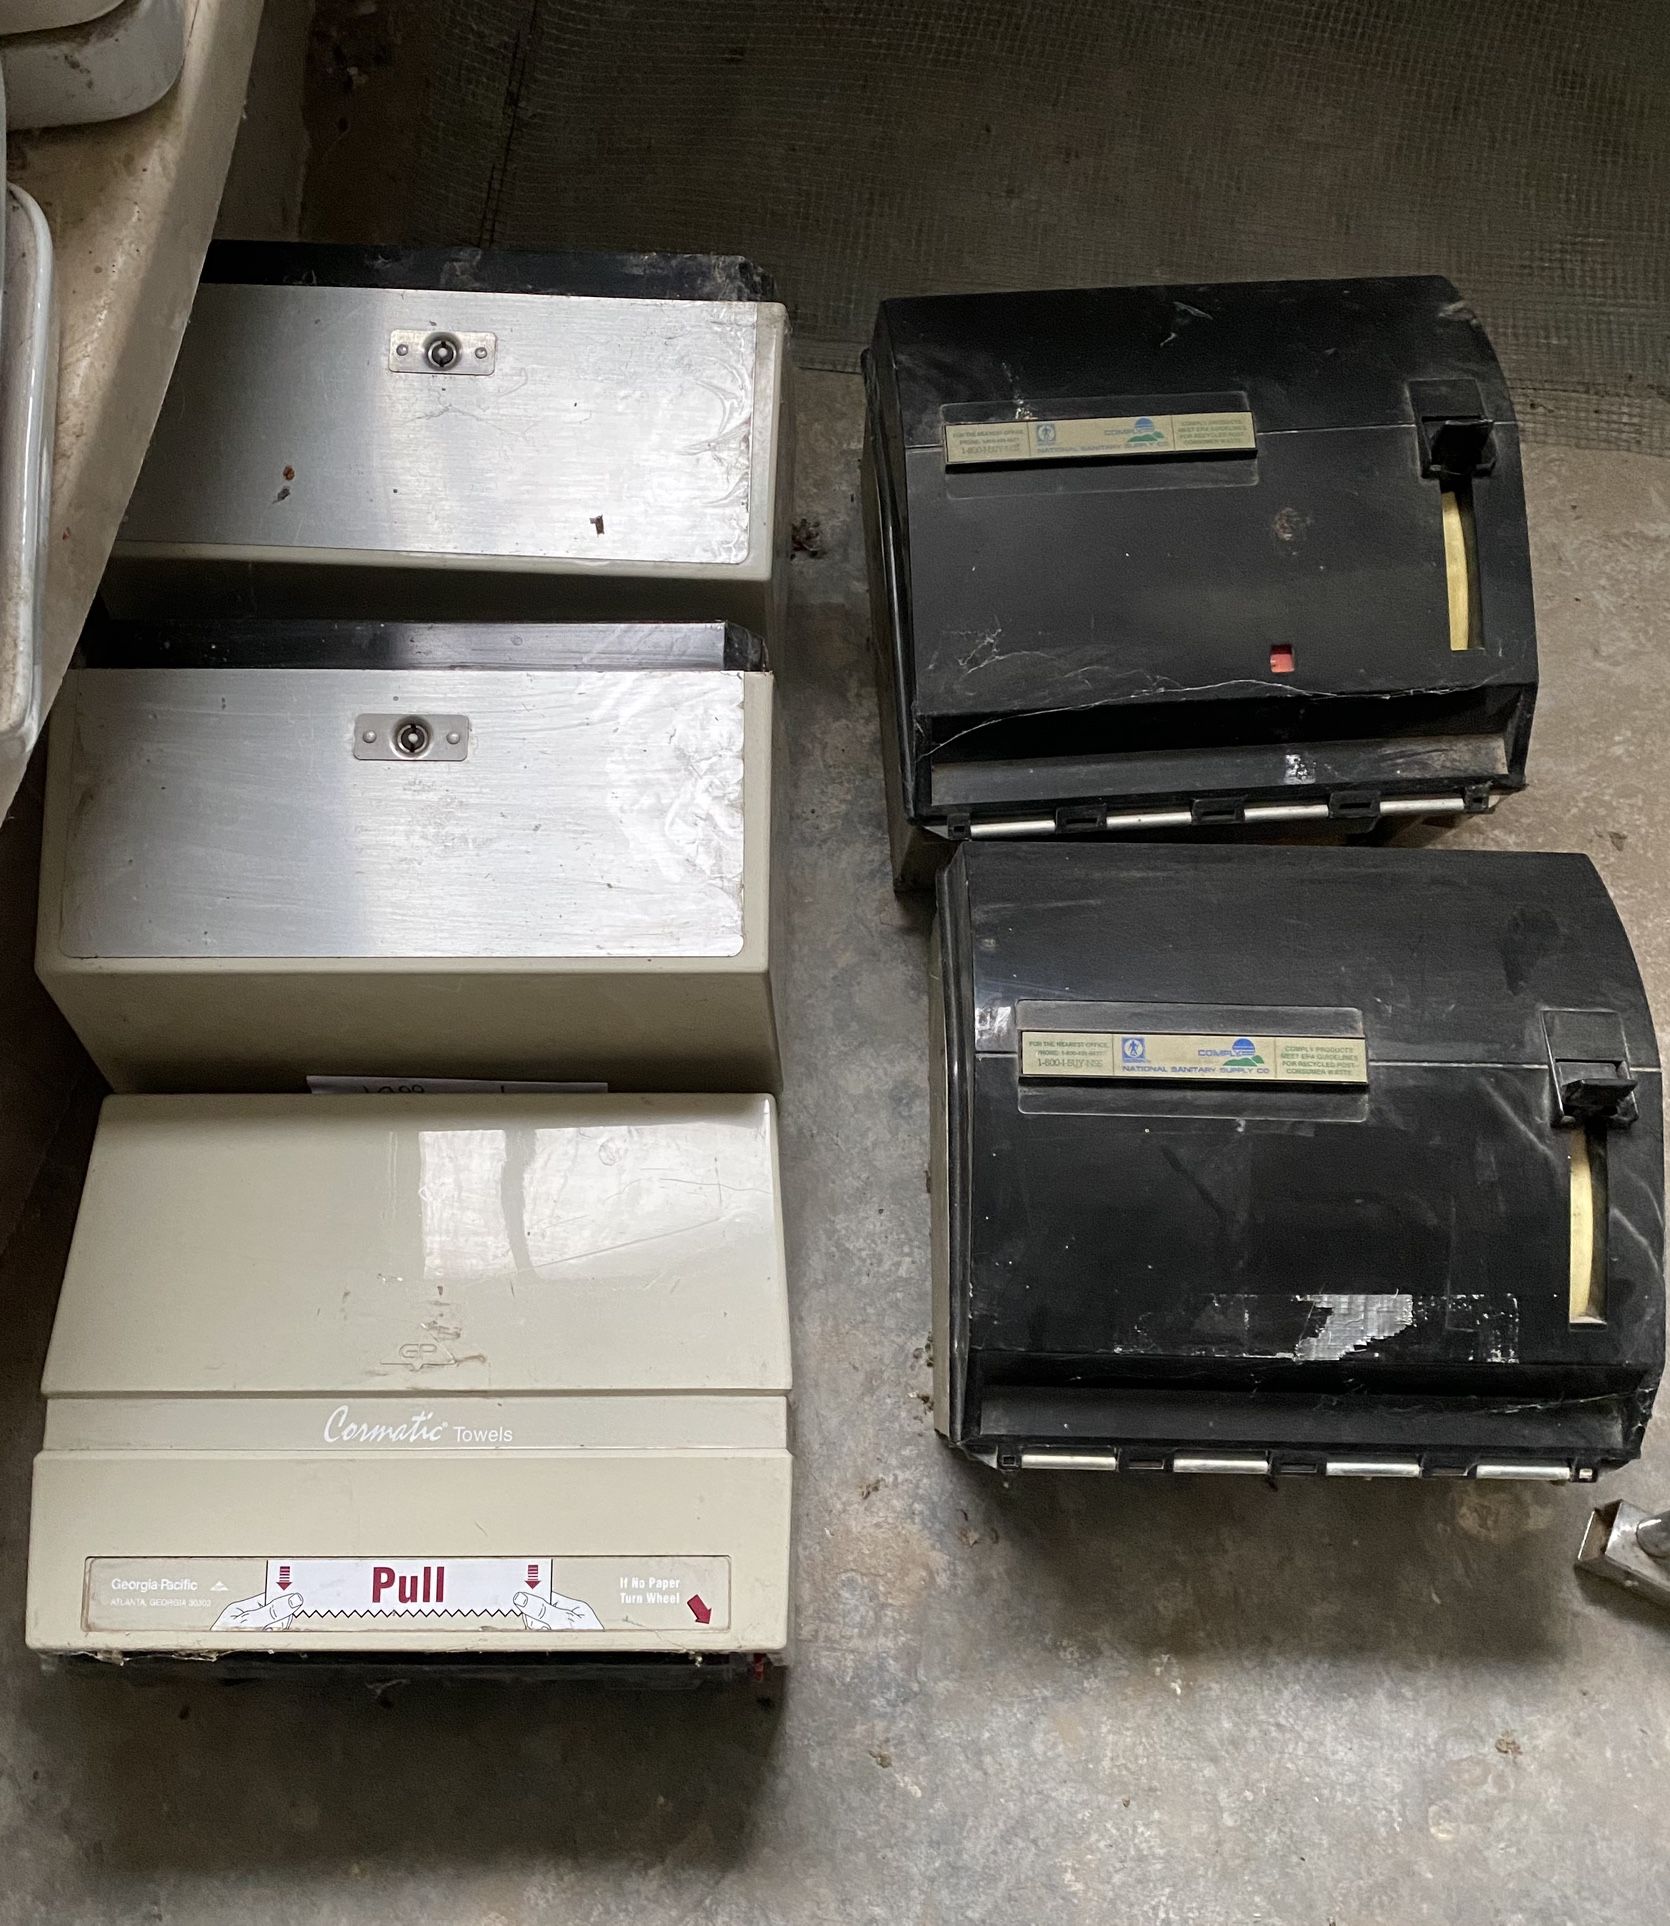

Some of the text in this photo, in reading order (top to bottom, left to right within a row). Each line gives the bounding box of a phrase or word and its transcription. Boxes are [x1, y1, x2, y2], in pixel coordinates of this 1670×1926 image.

[1122, 1065, 1168, 1073] NATIONAL
[1171, 1066, 1215, 1074] SANITARY
[453, 1426, 513, 1443] Towels
[372, 1566, 444, 1604] Pull
[619, 1577, 681, 1591] If No Paper
[149, 1598, 187, 1607] GEORGIA
[619, 1592, 680, 1605] Turn Wheel
